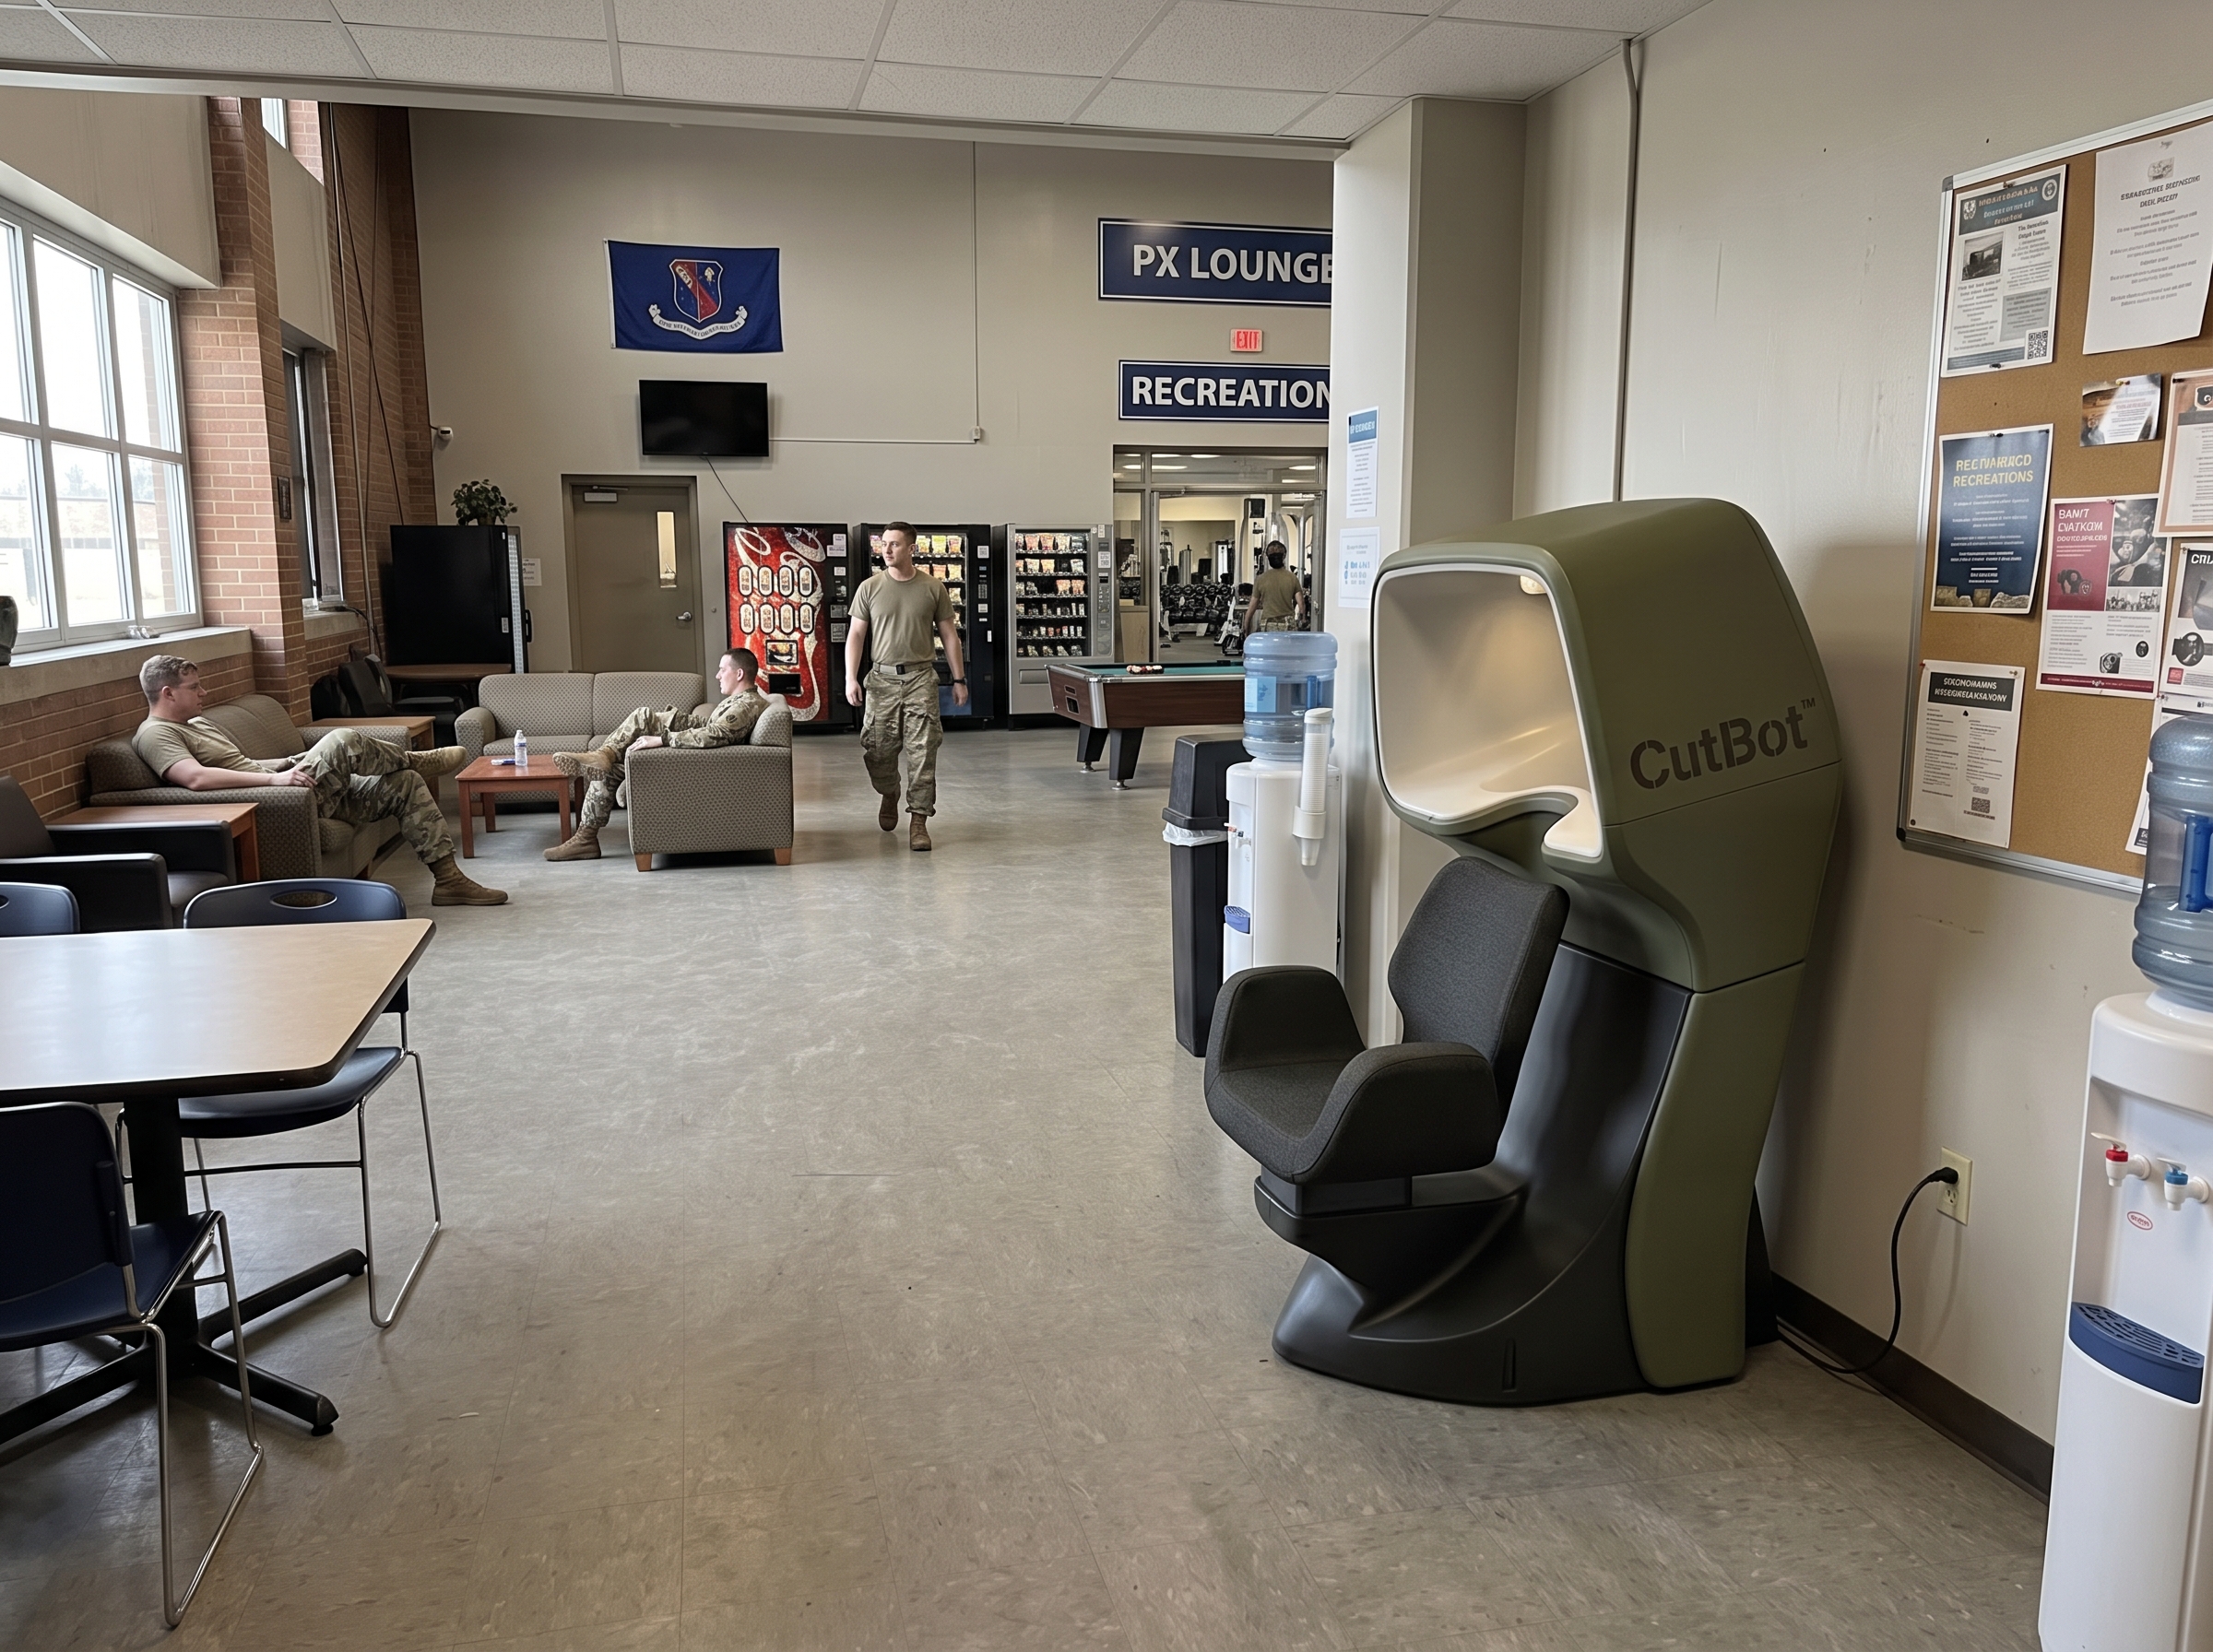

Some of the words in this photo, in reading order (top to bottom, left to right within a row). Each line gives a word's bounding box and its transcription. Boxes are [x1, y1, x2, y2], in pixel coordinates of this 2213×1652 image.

[1133, 244, 1180, 278] PX
[1190, 247, 1332, 284] LOUNGE
[1237, 331, 1260, 349] EXIT
[1131, 376, 1330, 408] RECREATION
[1953, 470, 2034, 488] RECREATIONS
